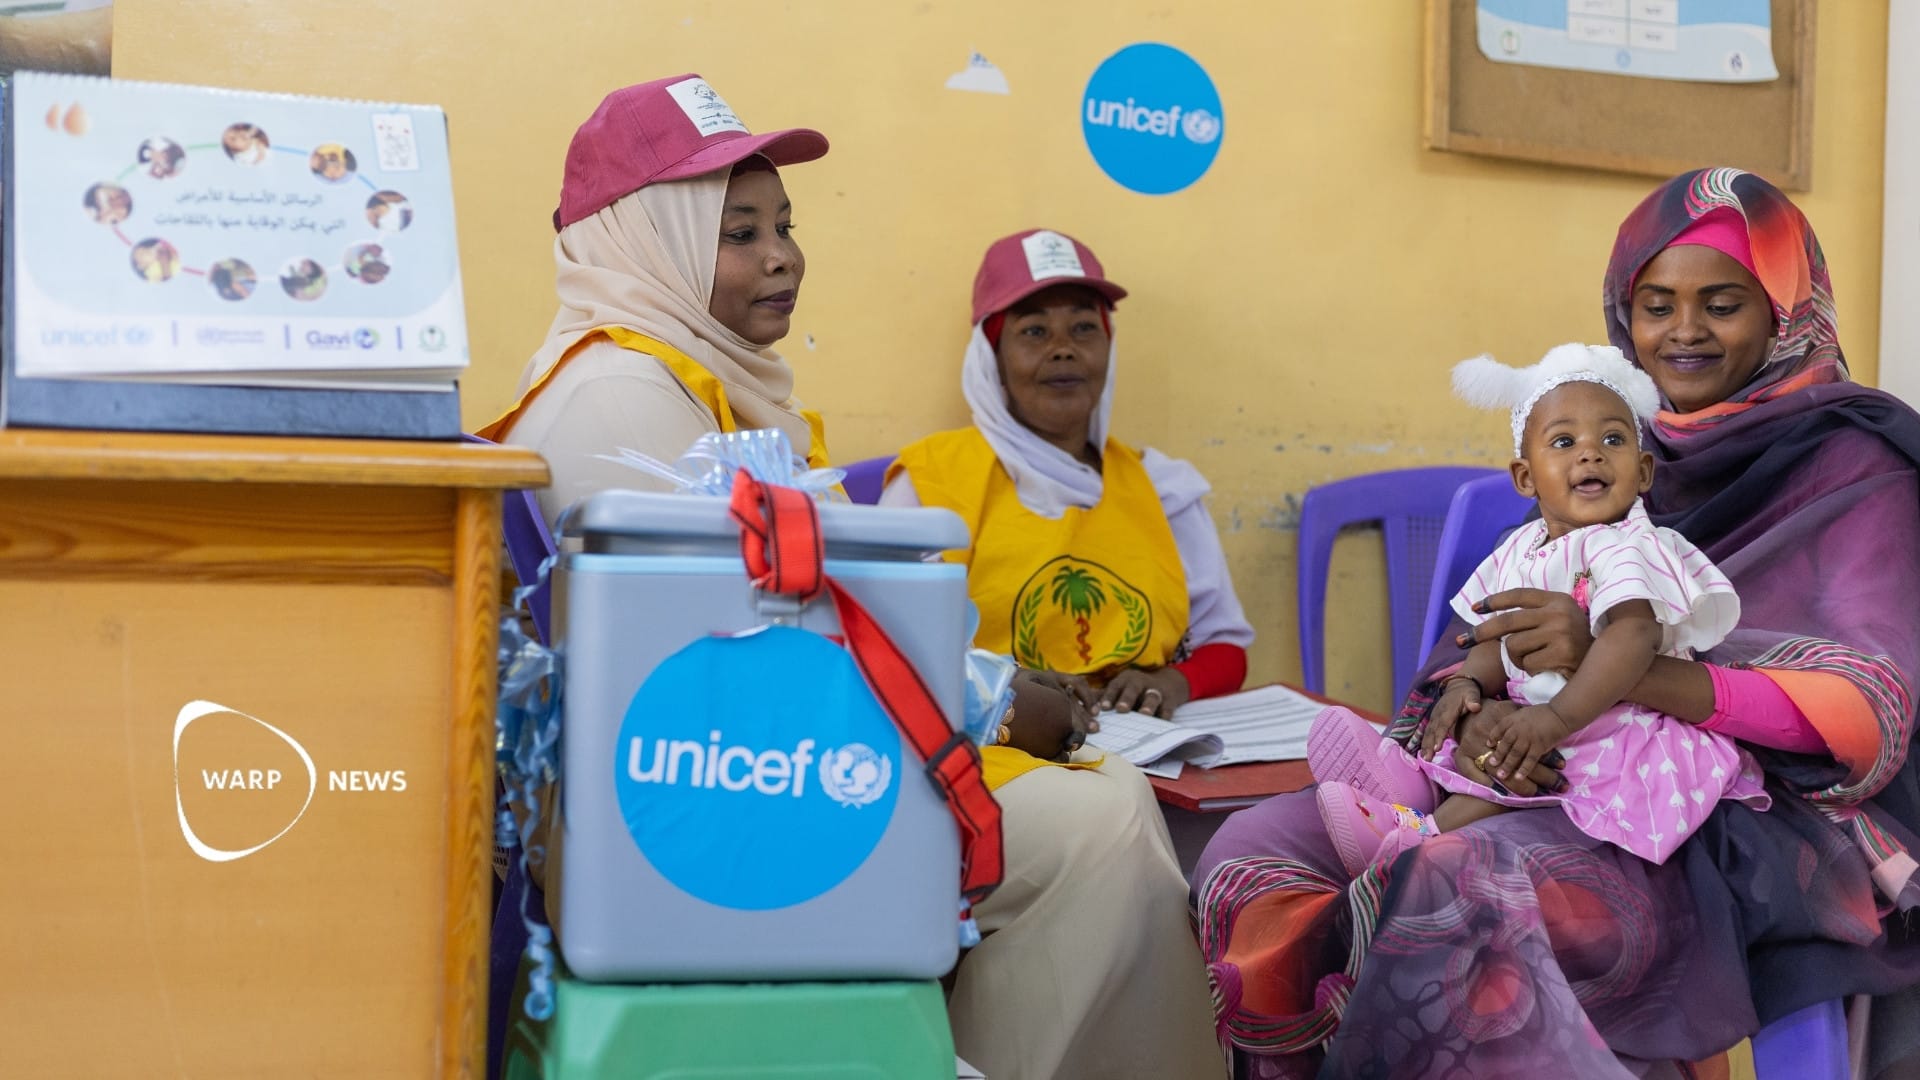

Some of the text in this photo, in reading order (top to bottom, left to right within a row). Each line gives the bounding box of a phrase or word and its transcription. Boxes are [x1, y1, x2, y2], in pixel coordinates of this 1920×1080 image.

[1086, 97, 1182, 138] unicef
[41, 321, 118, 347] unicef
[305, 330, 351, 346] Gavi
[628, 729, 815, 798] unicef
